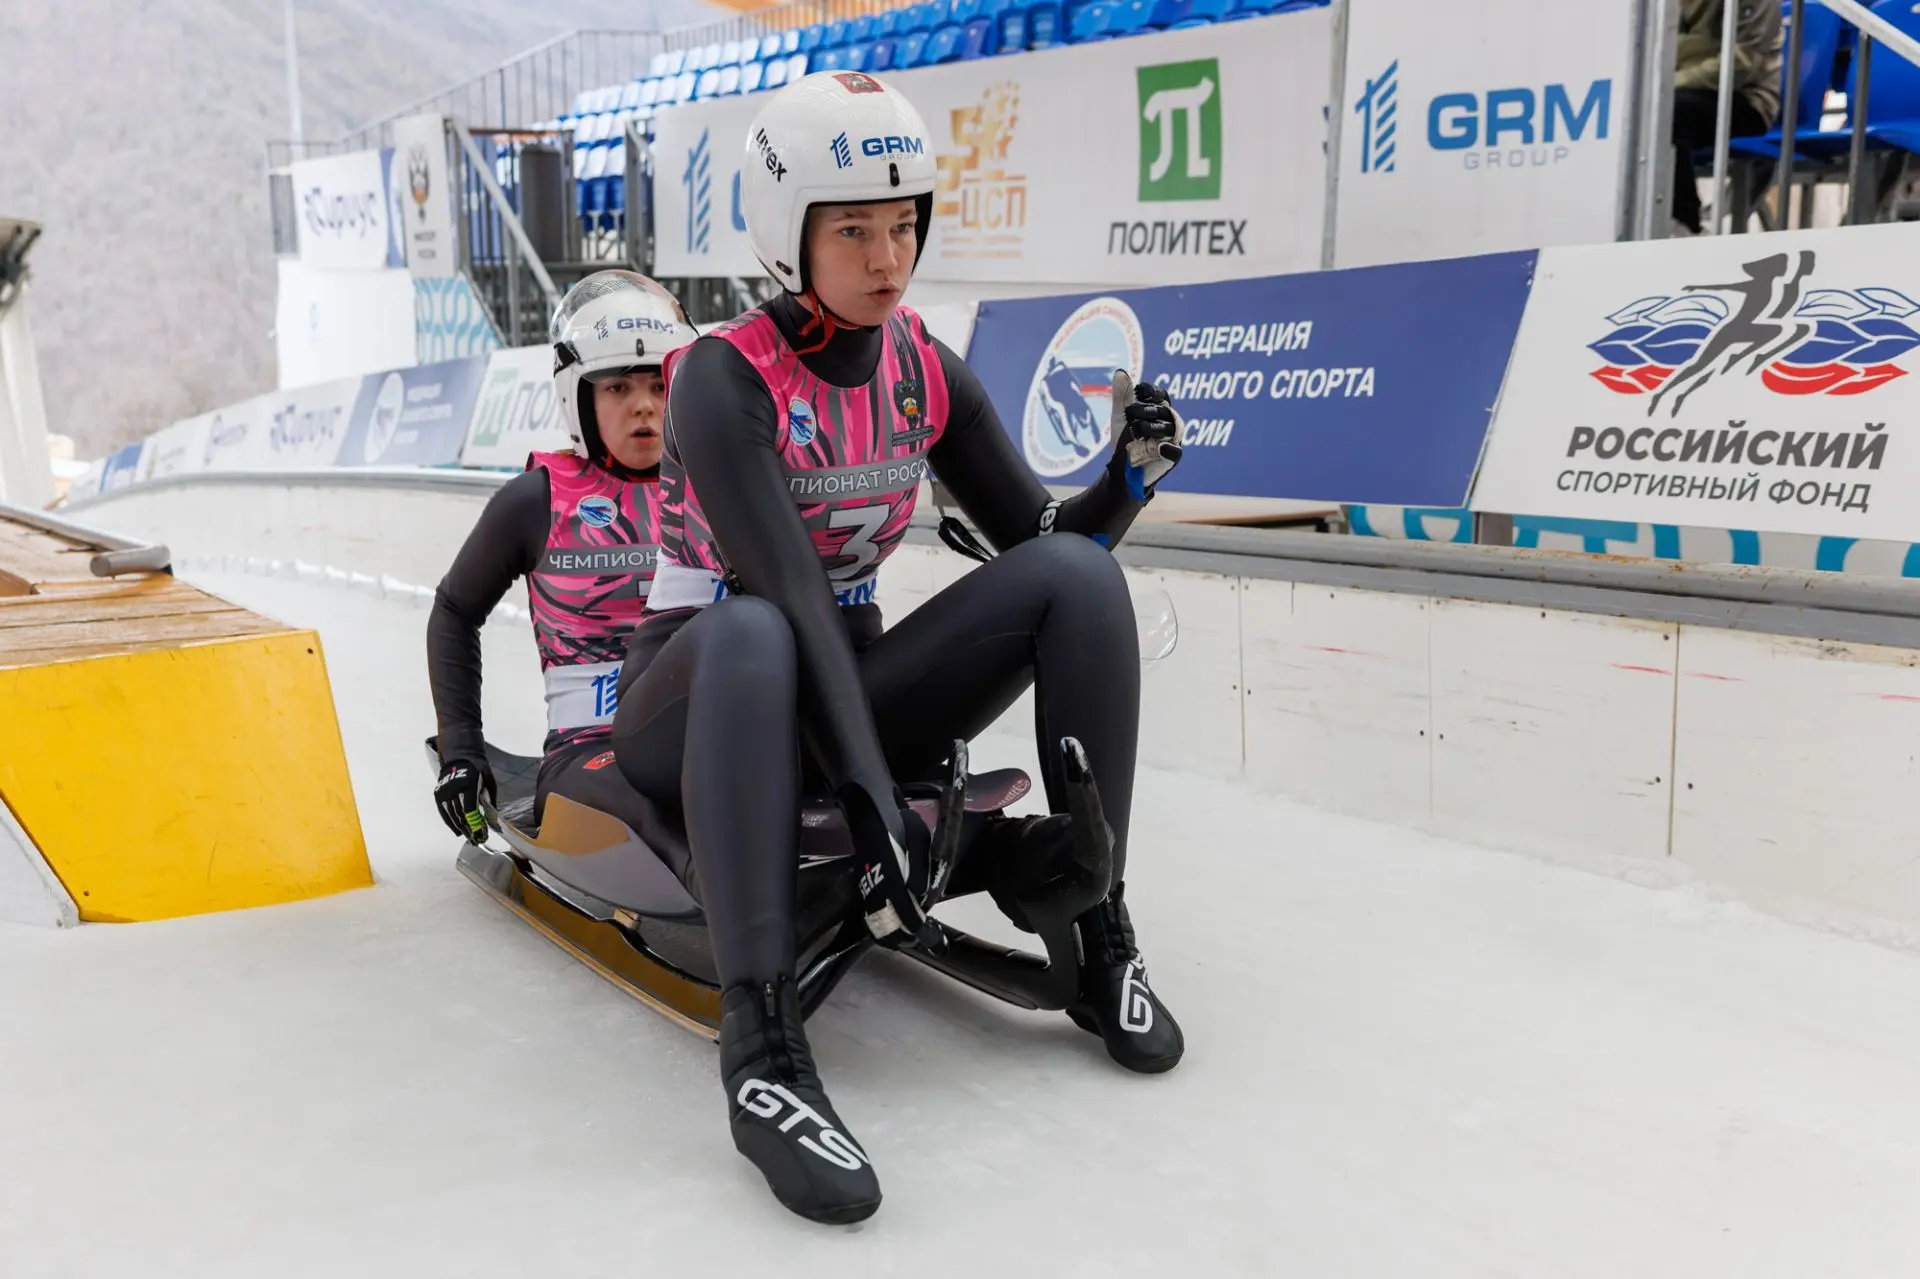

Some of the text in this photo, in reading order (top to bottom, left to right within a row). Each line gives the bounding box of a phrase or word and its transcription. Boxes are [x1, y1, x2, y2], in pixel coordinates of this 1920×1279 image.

[1428, 79, 1612, 151] GRM
[862, 136, 923, 157] GRM
[1463, 146, 1570, 170] GROUP
[961, 186, 1026, 230] ЦСП
[1108, 219, 1247, 255] ПОЛИТЕХ
[617, 317, 674, 334] GRM
[1164, 320, 1313, 359] ФЕДЕРАЦИЯ
[1154, 367, 1375, 400] САННОГО СПОРТА
[1182, 418, 1235, 447] СИИ
[1567, 420, 1889, 470] РОССИЙСКИЙ
[786, 458, 927, 494] ПИОНАТ РОСС
[1556, 470, 1871, 514] СПОРТИВНЫЙ ФОНД
[549, 551, 658, 569] ЧЕМПИОН
[825, 503, 891, 581] 3
[737, 1078, 870, 1171] GTS
